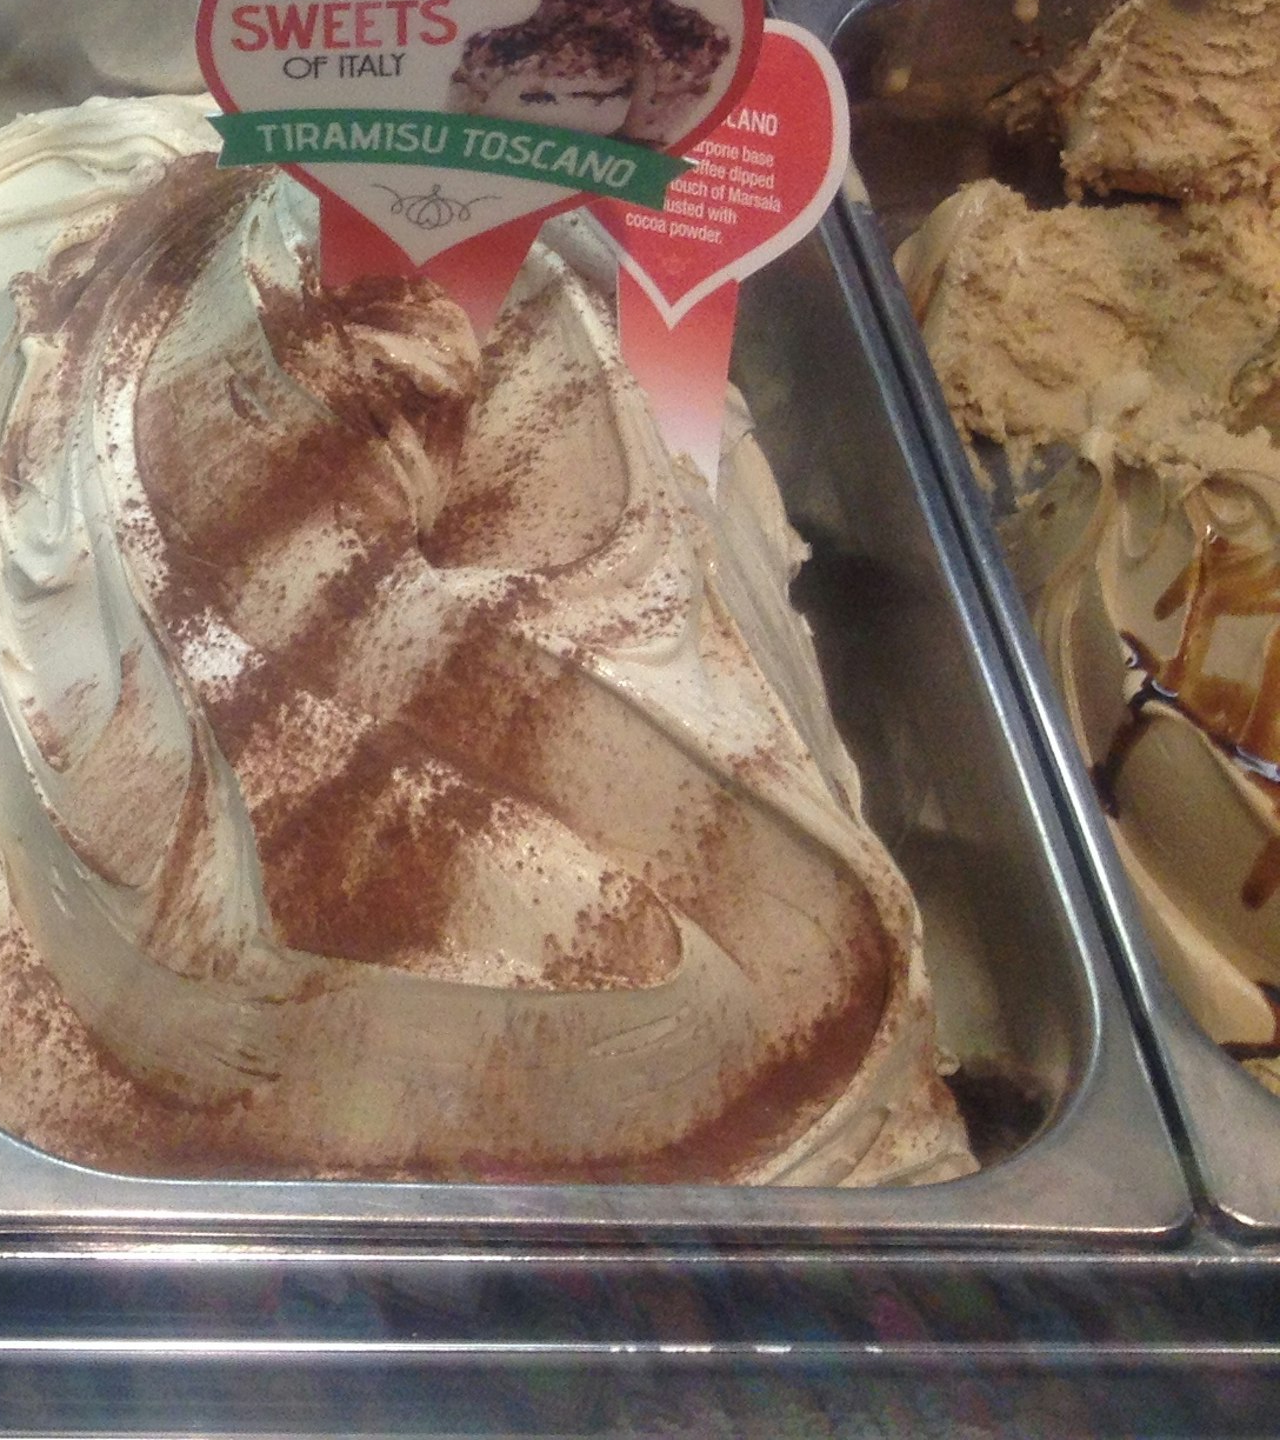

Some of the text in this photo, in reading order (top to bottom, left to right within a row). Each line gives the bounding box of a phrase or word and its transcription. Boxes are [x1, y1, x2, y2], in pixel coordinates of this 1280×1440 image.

[283, 53, 406, 80] OF ITALY
[257, 122, 638, 188] TIRAMISU TOSCANO
[742, 145, 775, 168] base
[729, 166, 775, 189] dipped
[711, 185, 726, 200] of
[728, 187, 781, 213] Marsala
[625, 212, 723, 244] cocoa powder.
[707, 207, 738, 225] with
